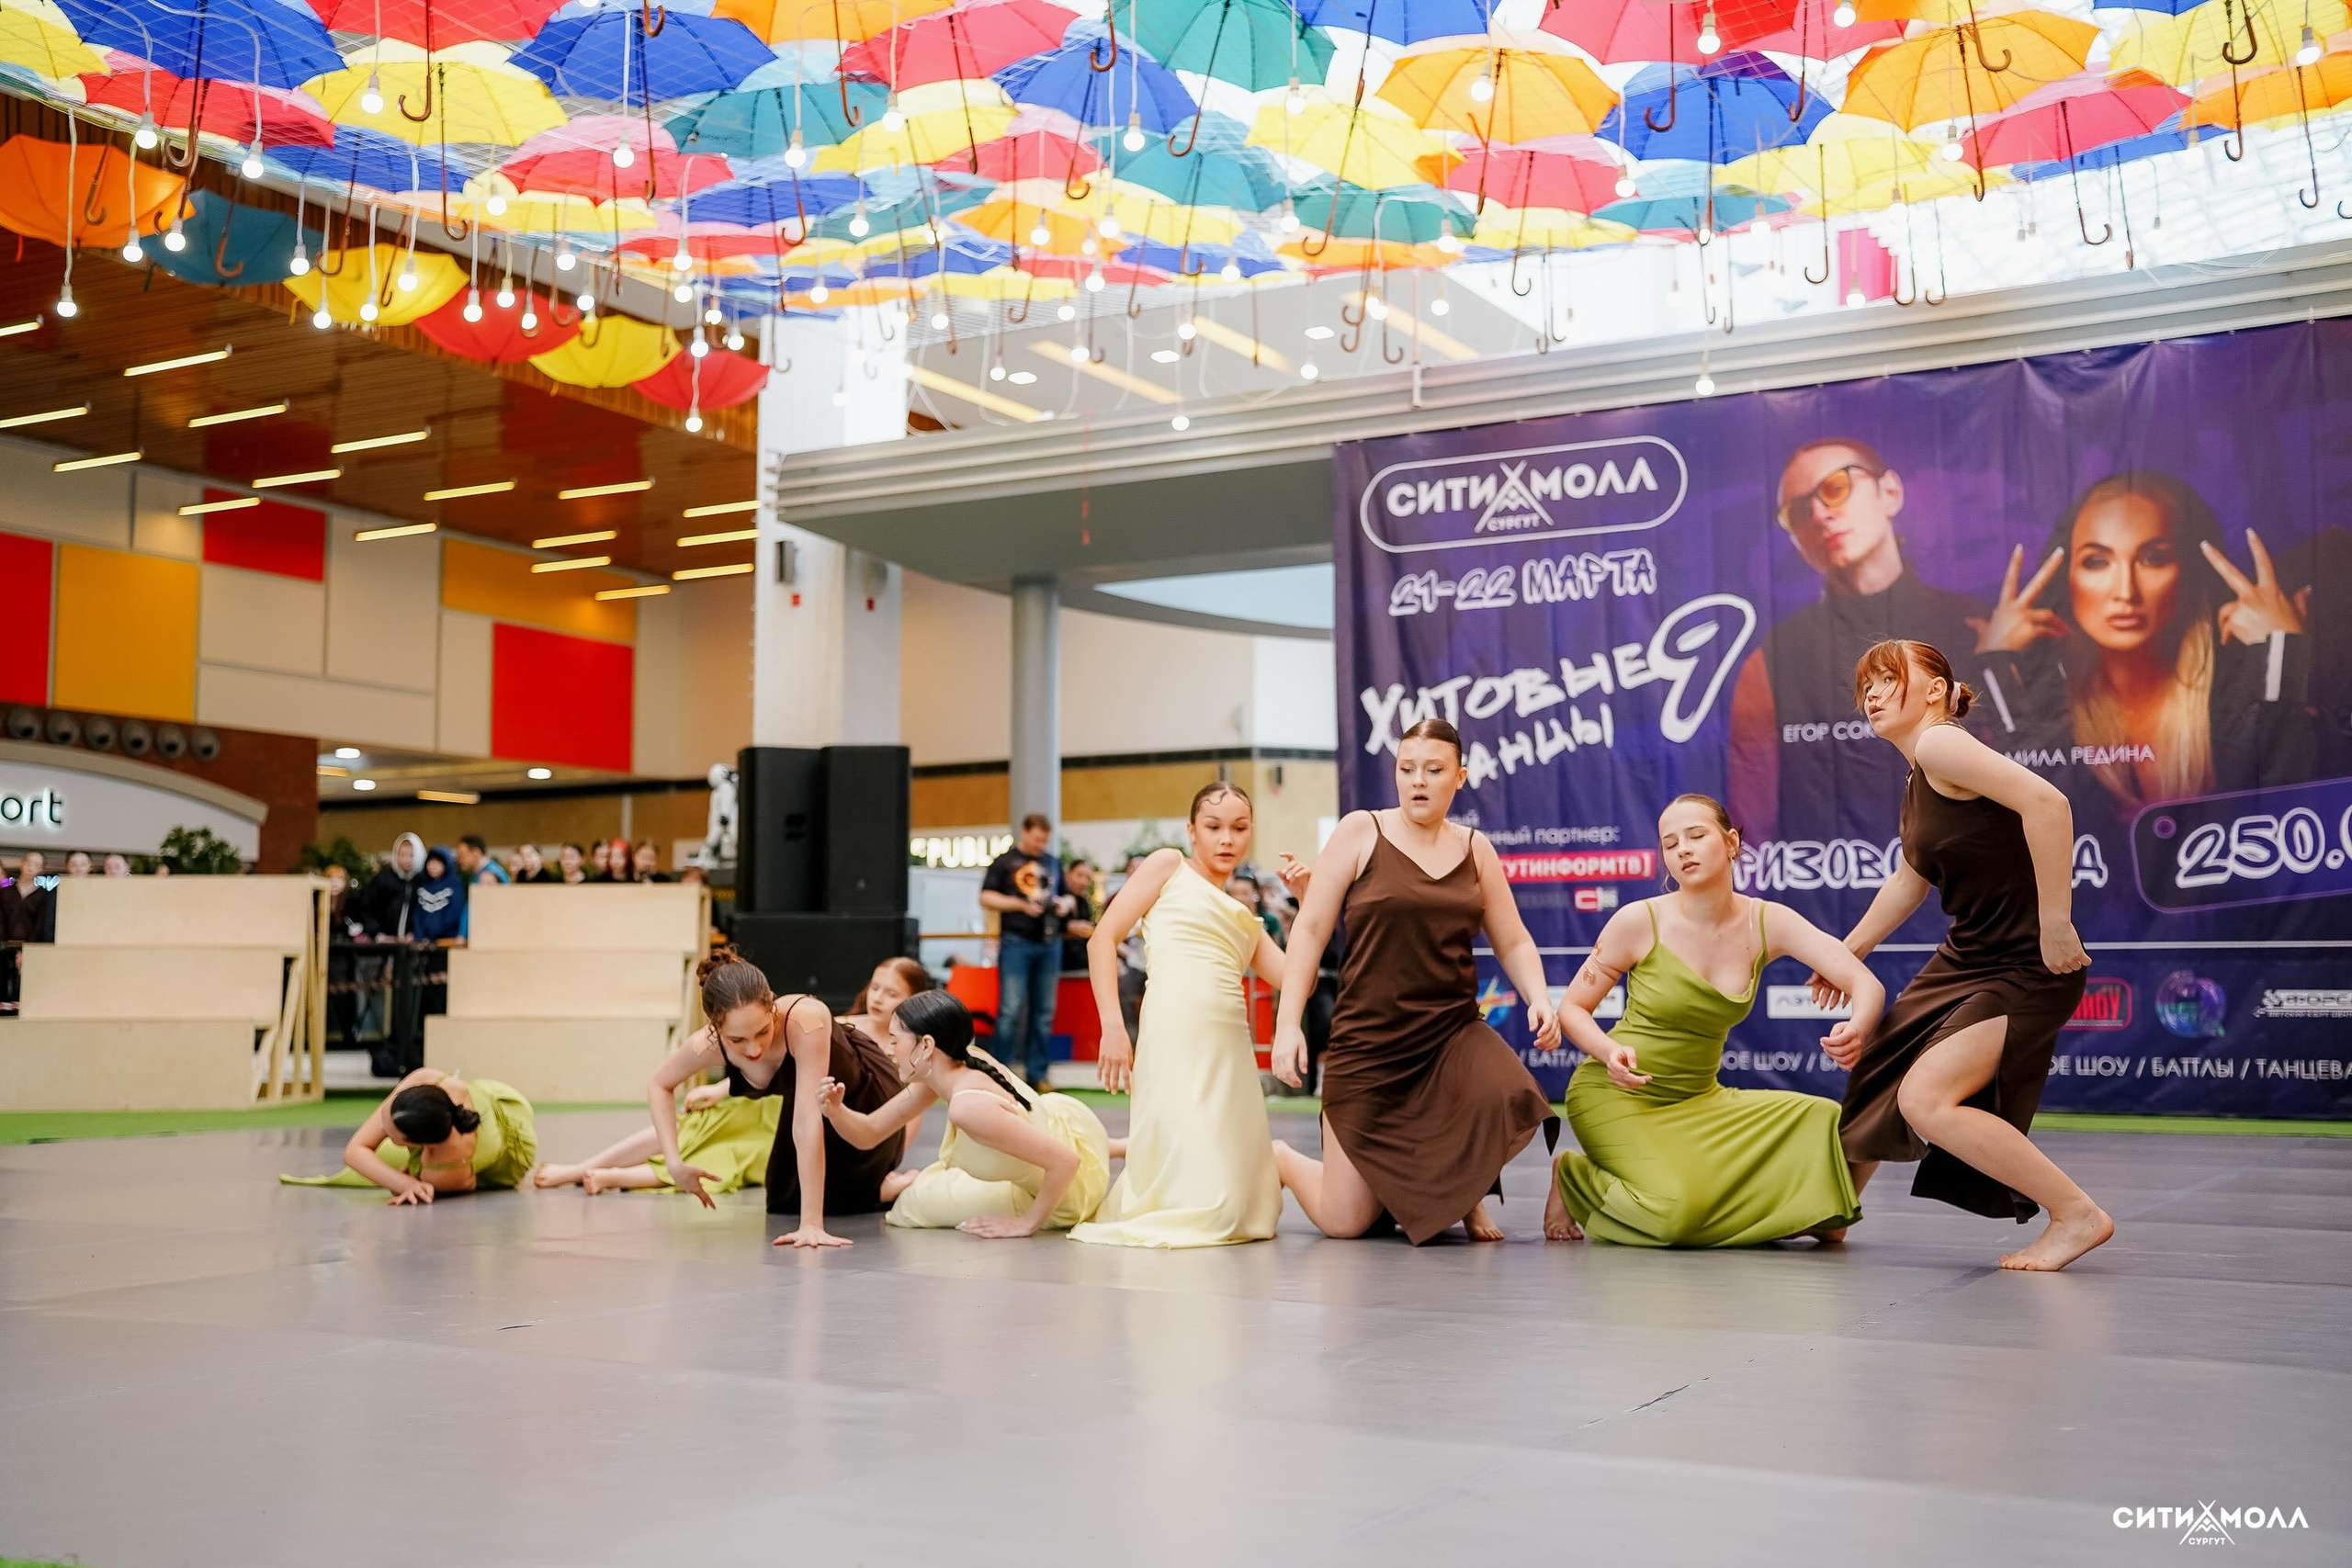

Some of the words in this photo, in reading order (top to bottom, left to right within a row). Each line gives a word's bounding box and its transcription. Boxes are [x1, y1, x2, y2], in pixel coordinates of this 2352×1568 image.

[1385, 472, 1498, 518] СИТИ
[1530, 457, 1658, 502] МОЛЛ
[1388, 564, 1518, 617] 21-22
[1521, 547, 1657, 604] МАРТА
[1461, 702, 1615, 790] АНЦЫ
[1782, 722, 1830, 743] ЕГОР
[2070, 744, 2156, 766] РЕДИНА
[2175, 804, 2352, 889] 250.
[1499, 851, 1652, 879] УТИНФОРМТВ]
[1754, 1051, 1804, 1072] ШОУ
[2075, 1055, 2131, 1077] ШОУ
[2151, 1057, 2234, 1078] БАТТЛЫ
